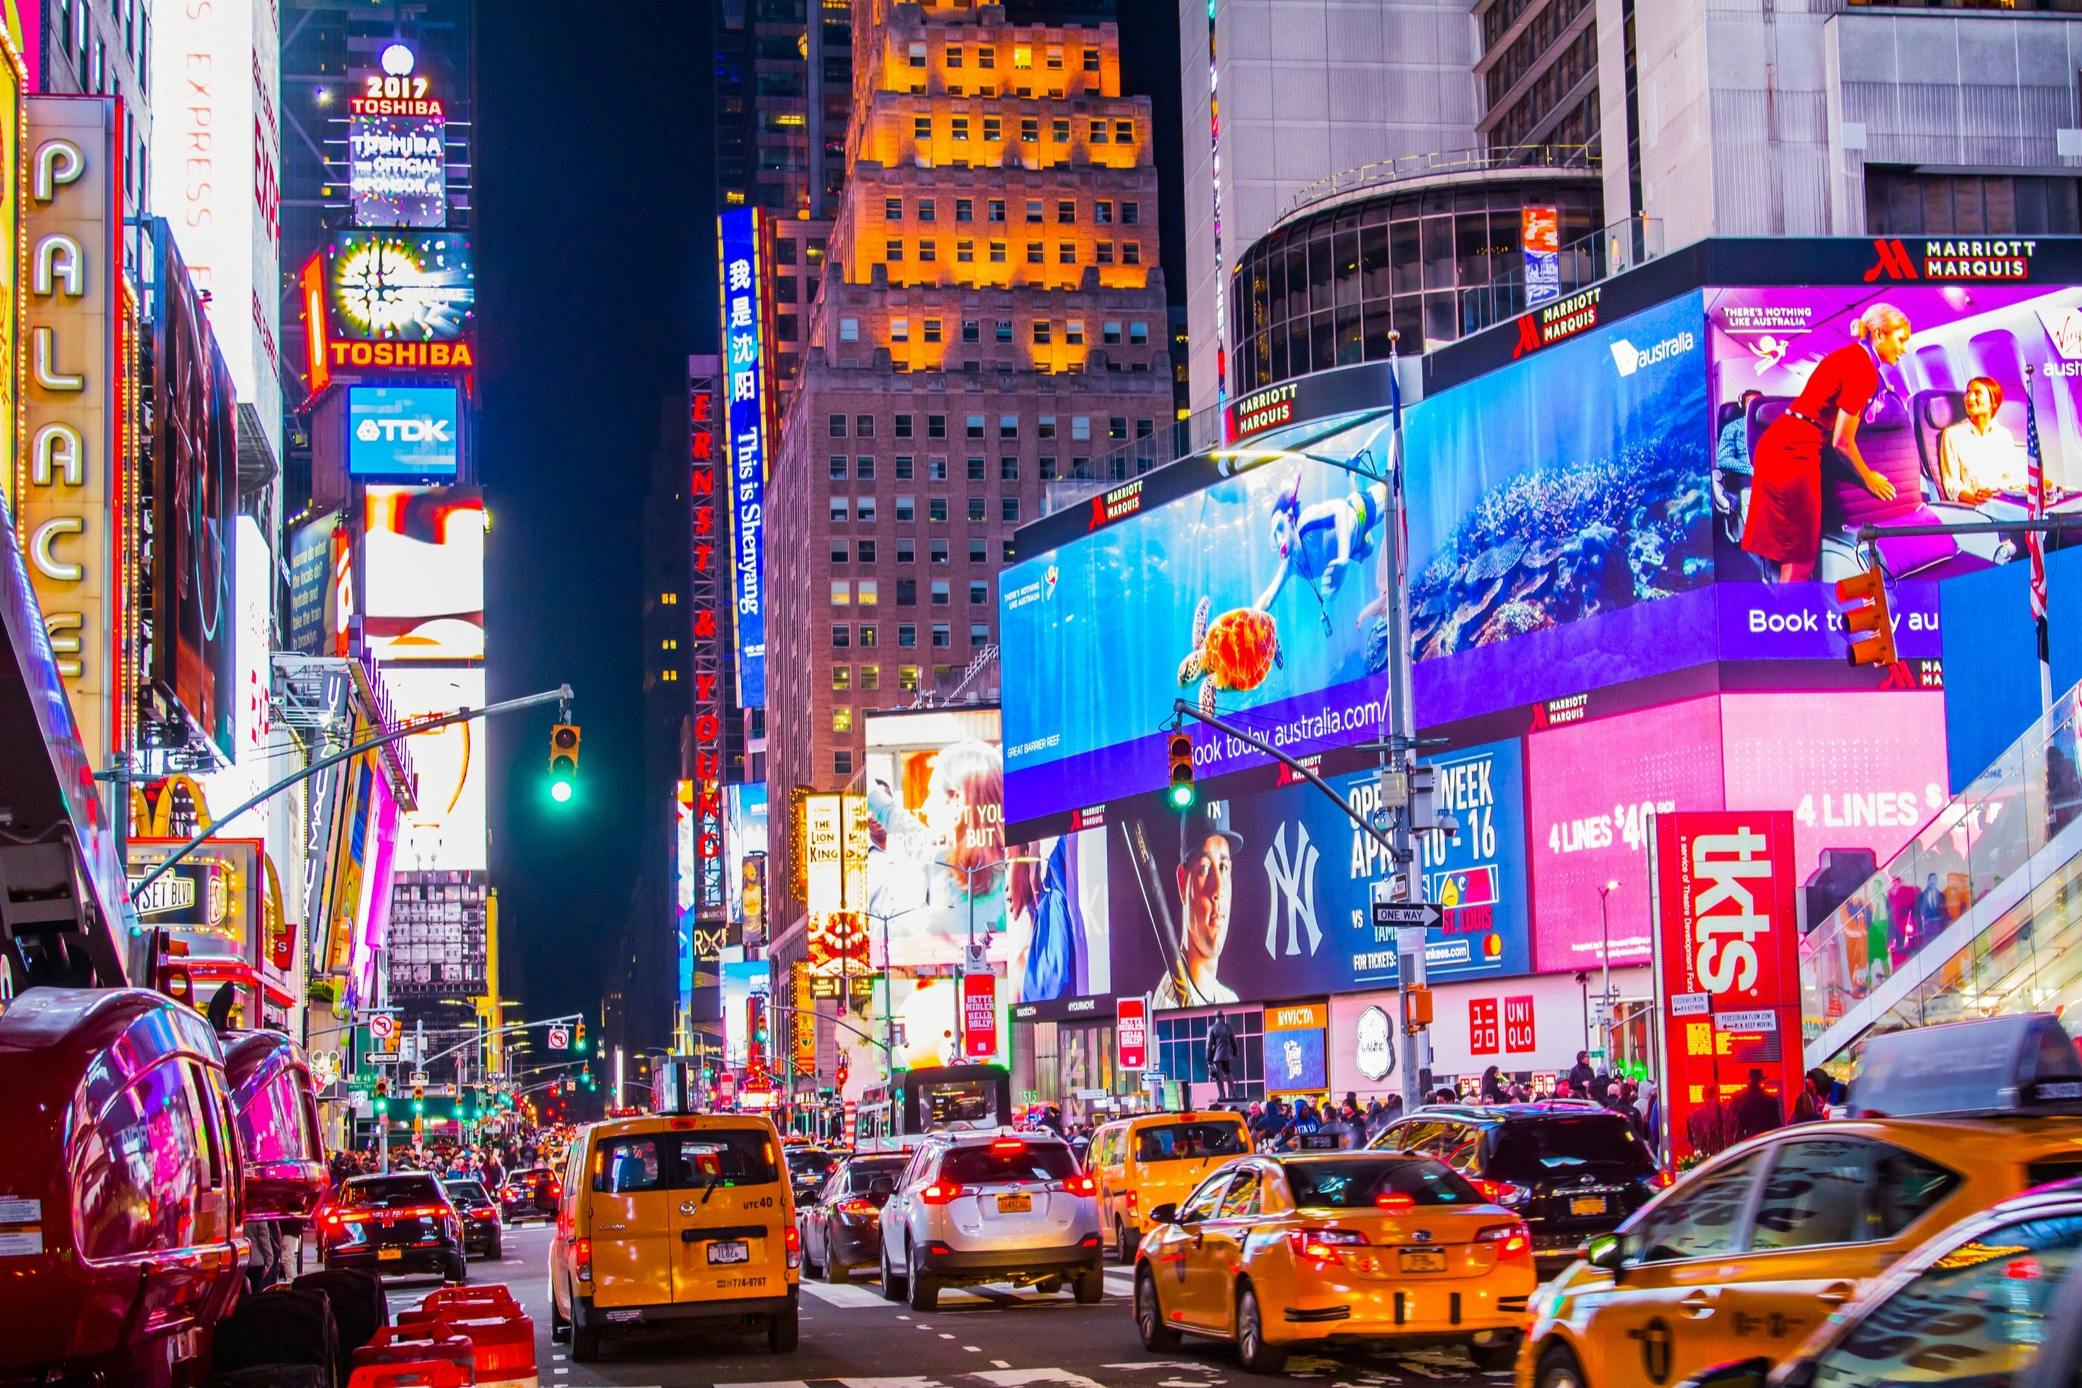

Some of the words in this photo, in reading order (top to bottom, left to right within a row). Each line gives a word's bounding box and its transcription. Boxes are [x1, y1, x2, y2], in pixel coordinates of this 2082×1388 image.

[367, 76, 428, 98] 2017
[352, 99, 442, 115] TOSHIBA
[186, 54, 212, 227] EXPRESS
[1927, 241, 2036, 257] MARRIOTT
[1928, 261, 2024, 276] MARQUIS
[1544, 287, 1601, 323] MARRIOTT
[1724, 307, 1763, 317] THERE'S
[1766, 307, 1812, 317] NOTHING
[729, 258, 756, 402] 我是沈阳
[1544, 309, 1595, 341] MARQUIS
[1730, 317, 1751, 327] LIKE
[1753, 317, 1806, 327] AUSTRALIA
[331, 342, 472, 366] TOSHIBA
[1638, 332, 1694, 369] australia
[1240, 383, 1297, 416] MARRIOTT
[1240, 404, 1290, 434] MARQUIS
[378, 419, 449, 442] TDK
[738, 426, 759, 480] This
[691, 394, 713, 572] ERNST
[740, 482, 759, 502] is
[1107, 480, 1143, 504] MARRIOTT
[1107, 496, 1140, 519] MARQUIS
[737, 503, 762, 615] Shenyang
[1020, 581, 1040, 597] NOTHING
[1749, 608, 1818, 632] Book
[1550, 694, 1588, 712] MARRIOTT
[1550, 708, 1584, 725] MARQUIS
[1007, 744, 1023, 759] GREAT
[1023, 738, 1047, 754] BARRIER
[1046, 733, 1060, 748] REEF
[1226, 726, 1270, 757] today
[696, 674, 719, 858] YOUNG
[1082, 804, 1106, 817] MARRIOTT
[1082, 814, 1103, 827] MARQUIS
[1796, 793, 1816, 828] 4
[1823, 791, 1919, 827] LINES
[814, 820, 831, 829] THE
[1468, 806, 1496, 861] 16
[1549, 823, 1560, 854] 4
[1562, 814, 1613, 853] LINES
[811, 831, 835, 845] LION
[966, 828, 995, 848] BUT
[810, 846, 838, 863] KING
[1681, 843, 1690, 873] service
[1682, 874, 1691, 883] of
[1682, 884, 1691, 916] Theatre
[1692, 826, 1772, 994] tkts
[1351, 909, 1363, 929] VS
[1380, 910, 1399, 920] ONE
[1403, 910, 1423, 919] WAY
[1460, 903, 1493, 933] LOUIS
[1684, 917, 1694, 971] Development
[1354, 954, 1368, 971] FOR
[1368, 950, 1397, 970] TICKETS:
[1687, 972, 1695, 993] Fund
[965, 1003, 995, 1011] MIDLER
[1278, 1008, 1314, 1026] INVICTA
[1507, 1002, 1529, 1022] UNI
[1721, 1014, 1748, 1022] PEDESTRIAN
[1748, 1013, 1760, 1021] FLOW
[1761, 1012, 1772, 1020] ZONE
[1756, 1021, 1774, 1029] MOVING
[1508, 1026, 1532, 1048] QLO
[743, 1200, 759, 1210] UTC
[759, 1197, 773, 1208] 40
